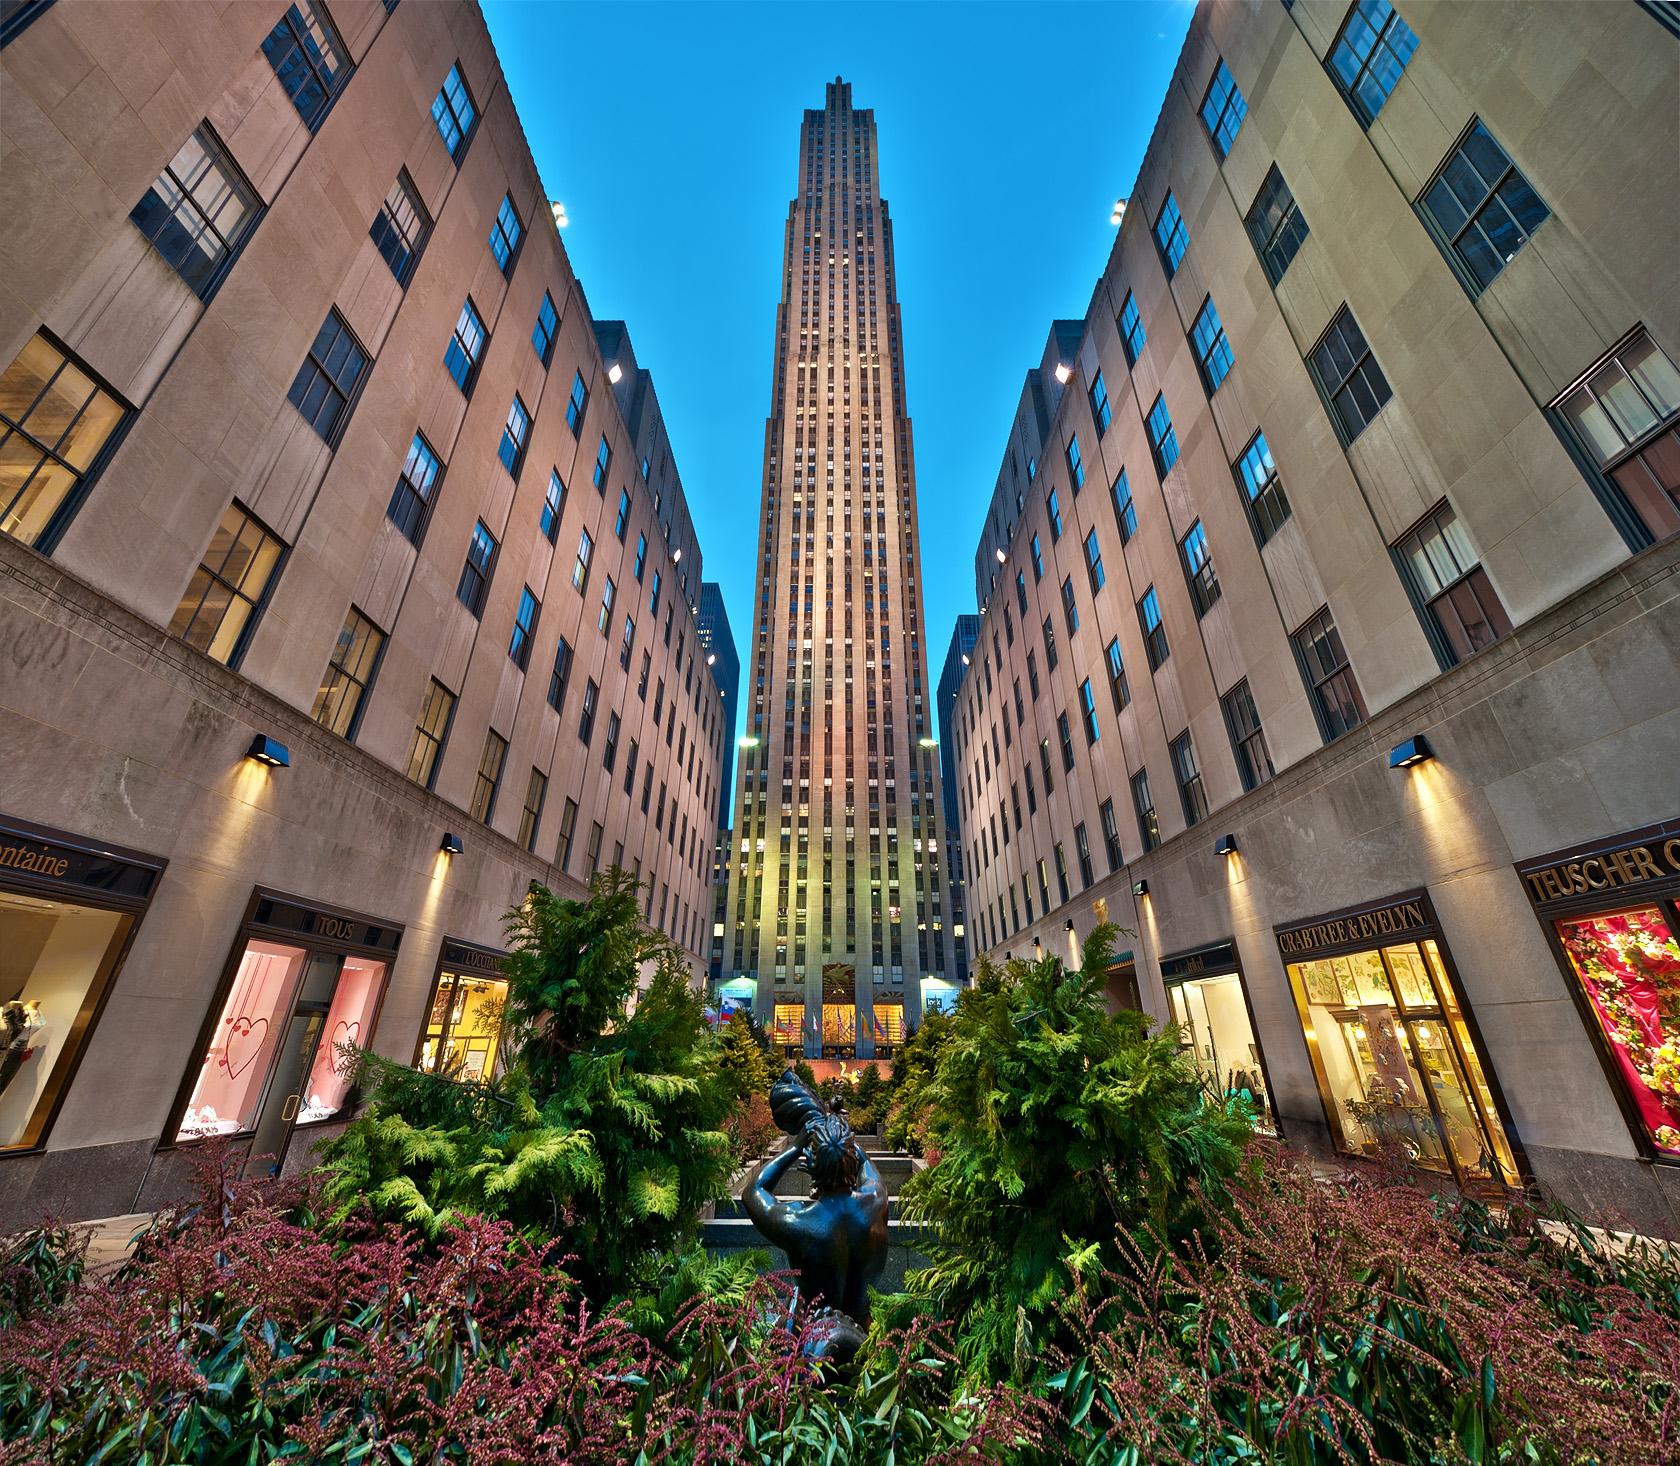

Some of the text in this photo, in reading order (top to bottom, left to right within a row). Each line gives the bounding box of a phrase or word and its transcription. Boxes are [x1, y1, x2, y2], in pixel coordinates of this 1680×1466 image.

[0, 844, 69, 877] ntaine
[1527, 847, 1666, 901] TEUSCHER
[320, 916, 354, 939] TOUS
[1279, 902, 1426, 953] CRABTREE & EVELYN
[465, 951, 501, 970] L'OCCITAN
